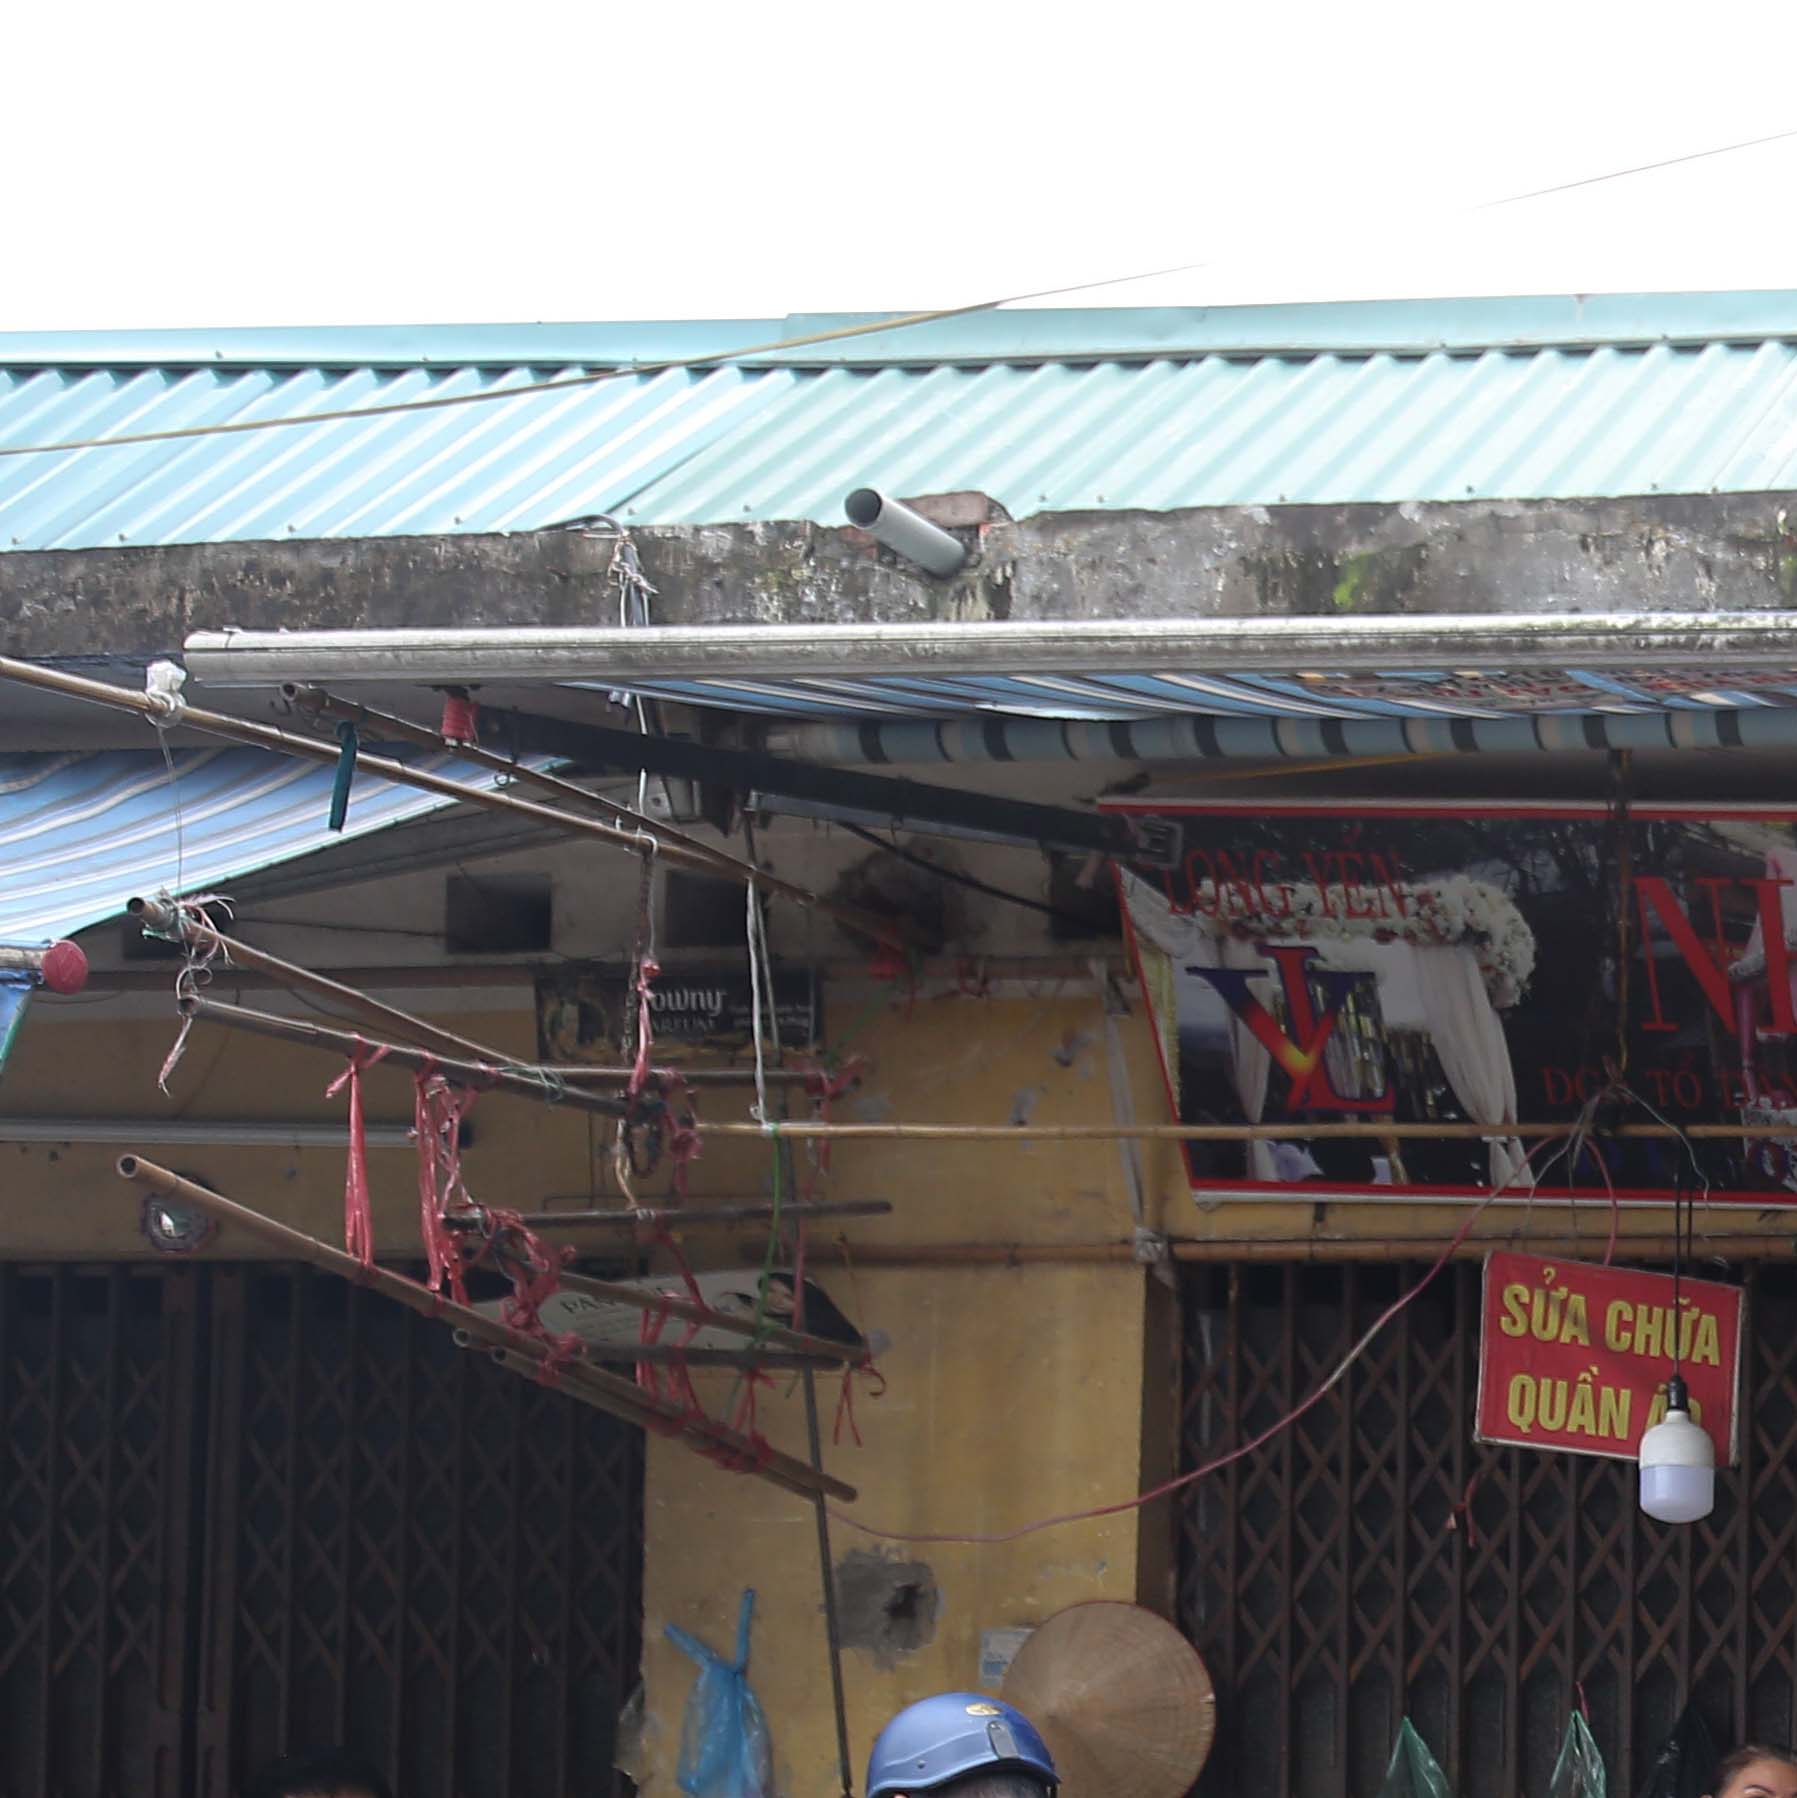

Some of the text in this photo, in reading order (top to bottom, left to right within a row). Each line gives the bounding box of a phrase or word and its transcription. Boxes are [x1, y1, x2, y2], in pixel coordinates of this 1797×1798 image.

[648, 987, 728, 1016] owny
[1499, 1266, 1721, 1368] SỬA CHỮA
[1507, 1365, 1632, 1441] QUẦN
